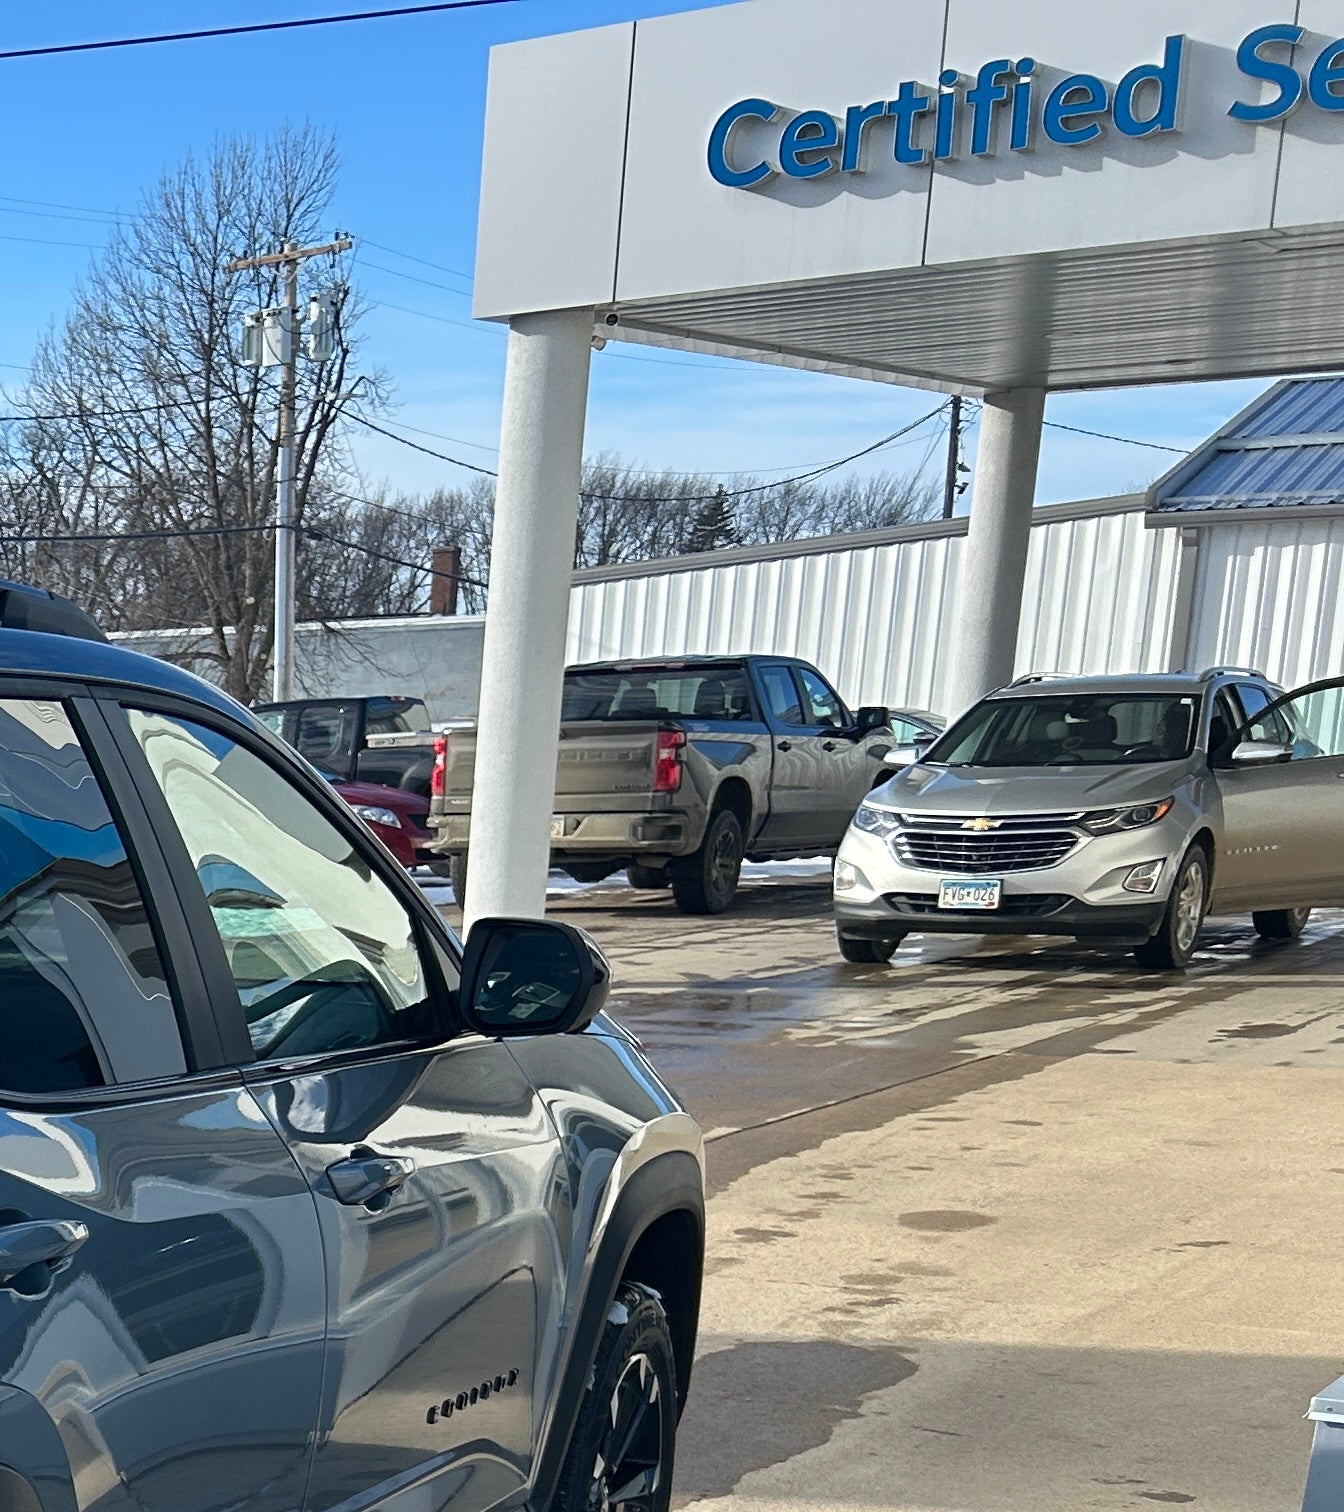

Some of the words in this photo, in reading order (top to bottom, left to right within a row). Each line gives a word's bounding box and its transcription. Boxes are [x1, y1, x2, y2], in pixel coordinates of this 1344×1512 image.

[706, 33, 1186, 188] Certified
[942, 887, 965, 902] FVG
[973, 887, 995, 902] 026
